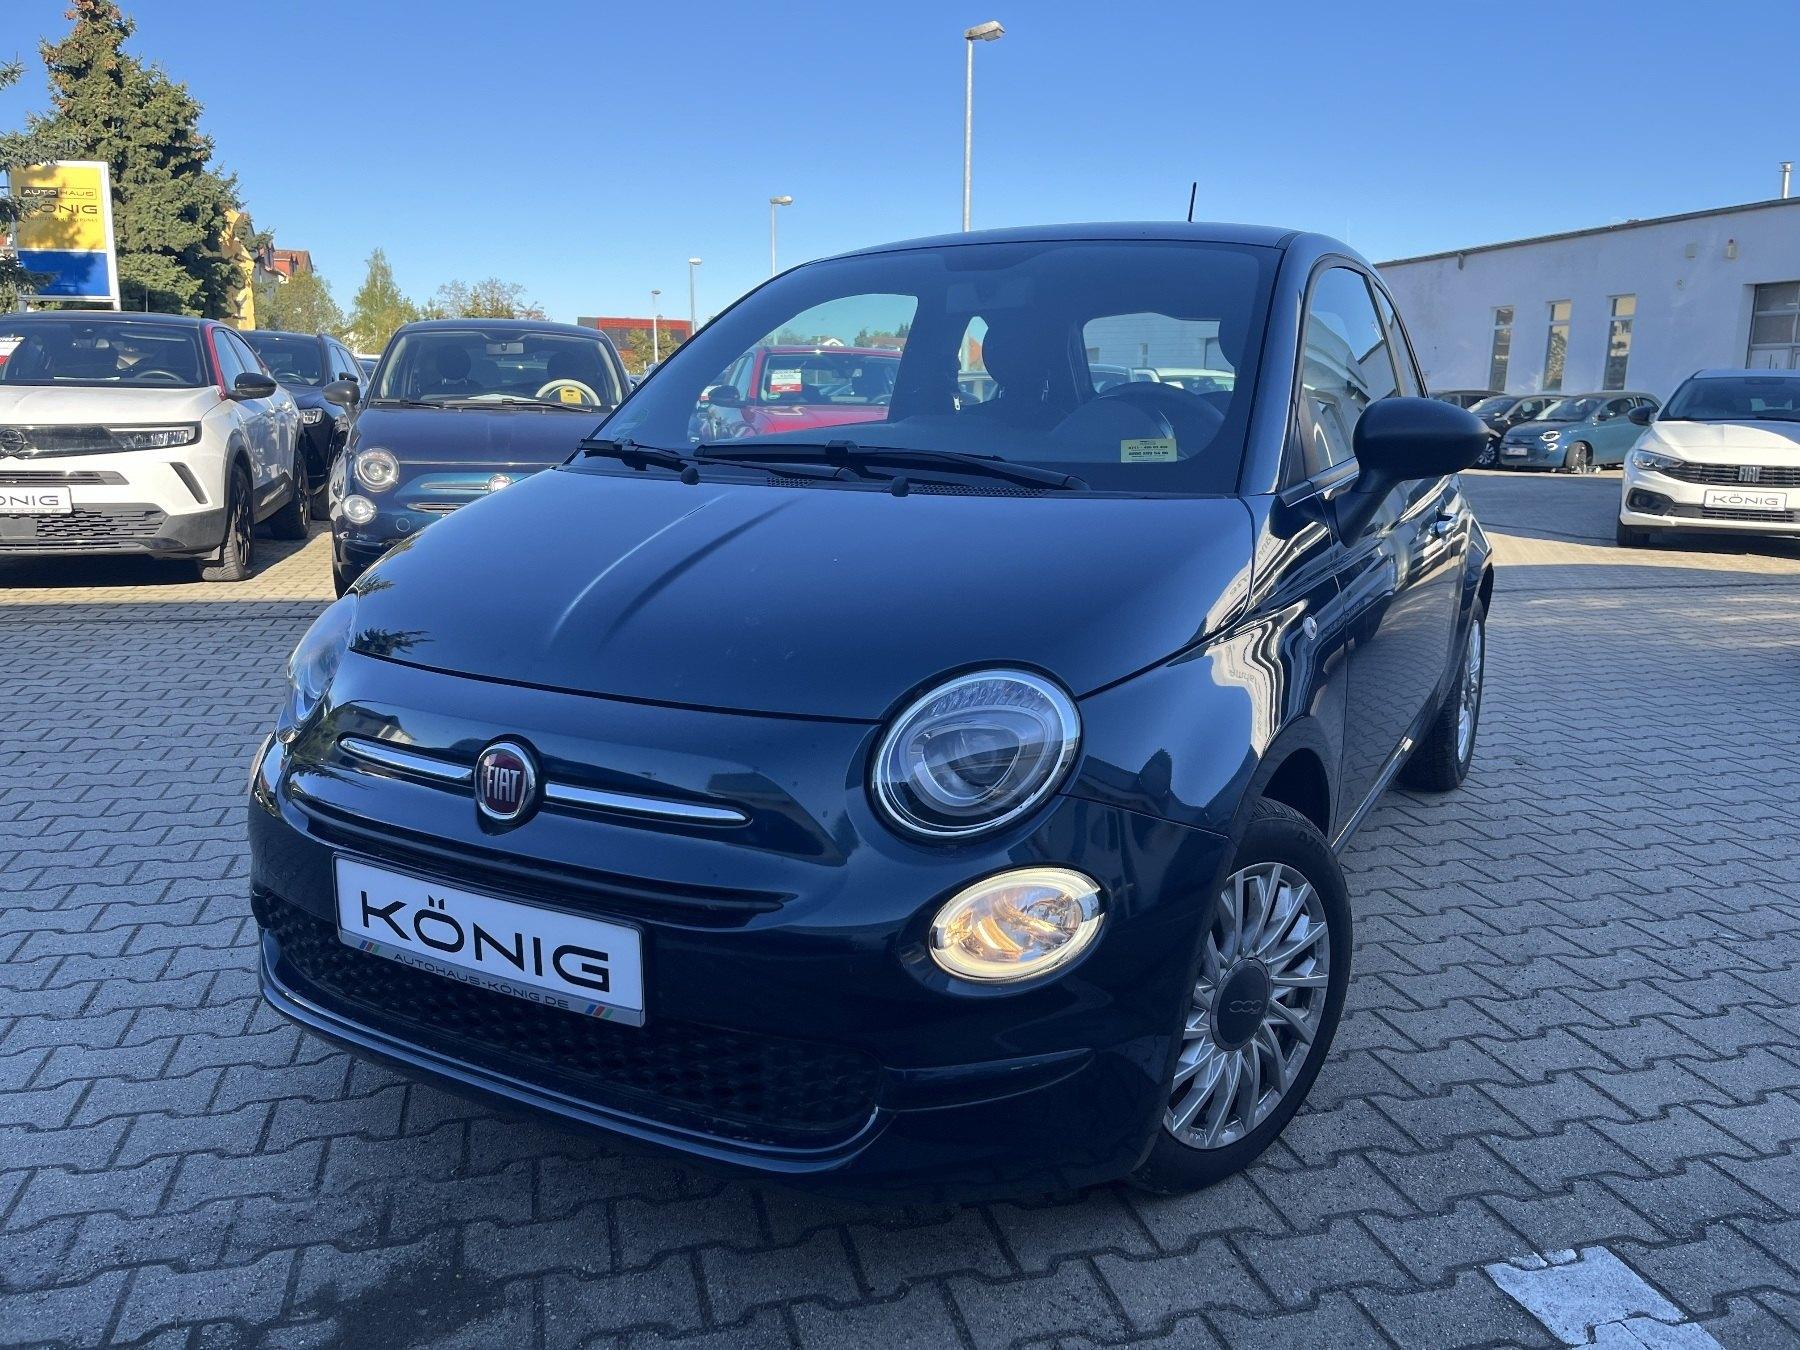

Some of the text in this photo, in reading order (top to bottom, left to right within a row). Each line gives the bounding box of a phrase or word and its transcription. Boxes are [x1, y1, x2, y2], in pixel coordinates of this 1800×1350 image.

[39, 201, 98, 214] ÖNIG
[1713, 493, 1778, 506] KÖNIG
[486, 765, 521, 803] FIAT
[360, 890, 610, 993] KÖNIG
[394, 953, 569, 1009] AUTOHAUS-KÖNIG.DE
